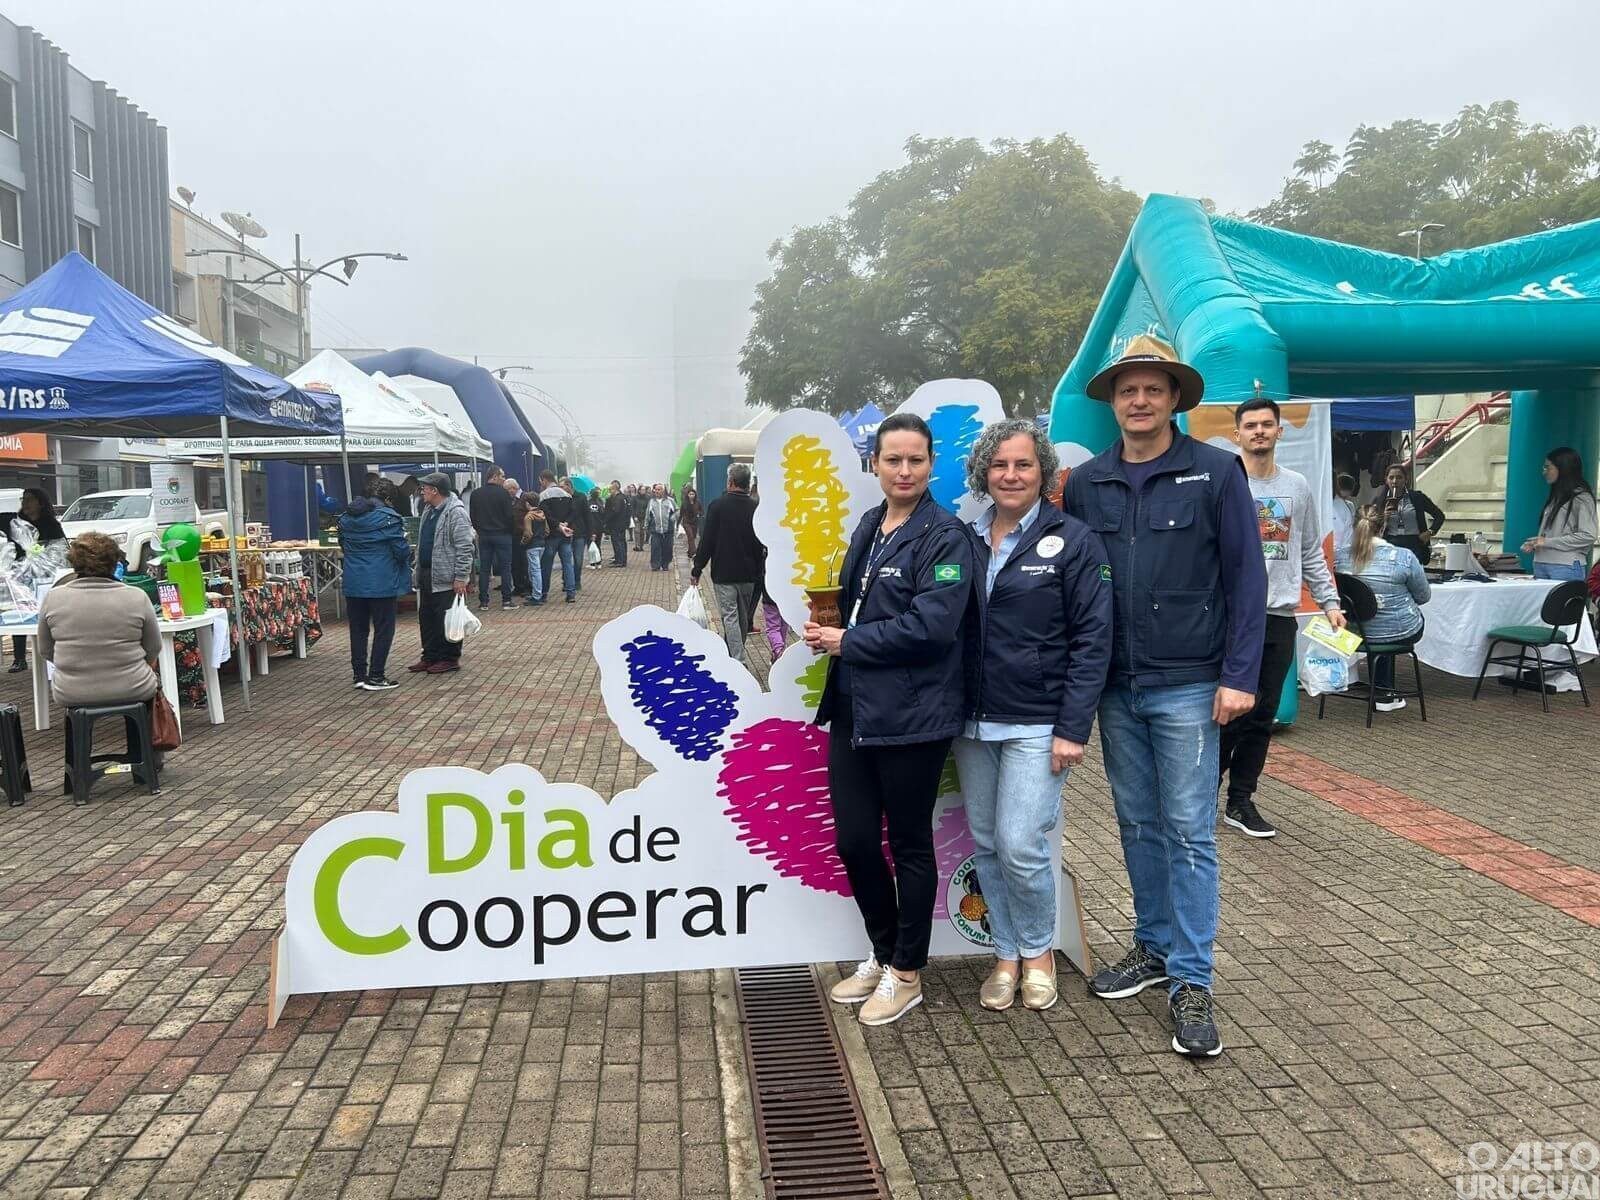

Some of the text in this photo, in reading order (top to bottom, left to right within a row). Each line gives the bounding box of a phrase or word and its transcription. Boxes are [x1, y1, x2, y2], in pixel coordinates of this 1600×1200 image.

[184, 440, 235, 449] OPORTUNIDE
[236, 439, 253, 447] PARA
[254, 439, 274, 447] QUEM
[345, 438, 361, 446] PARA
[363, 438, 382, 446] QUEM
[426, 789, 680, 874] Dia de
[314, 836, 768, 965] Cooperar
[953, 912, 986, 941] FORUM
